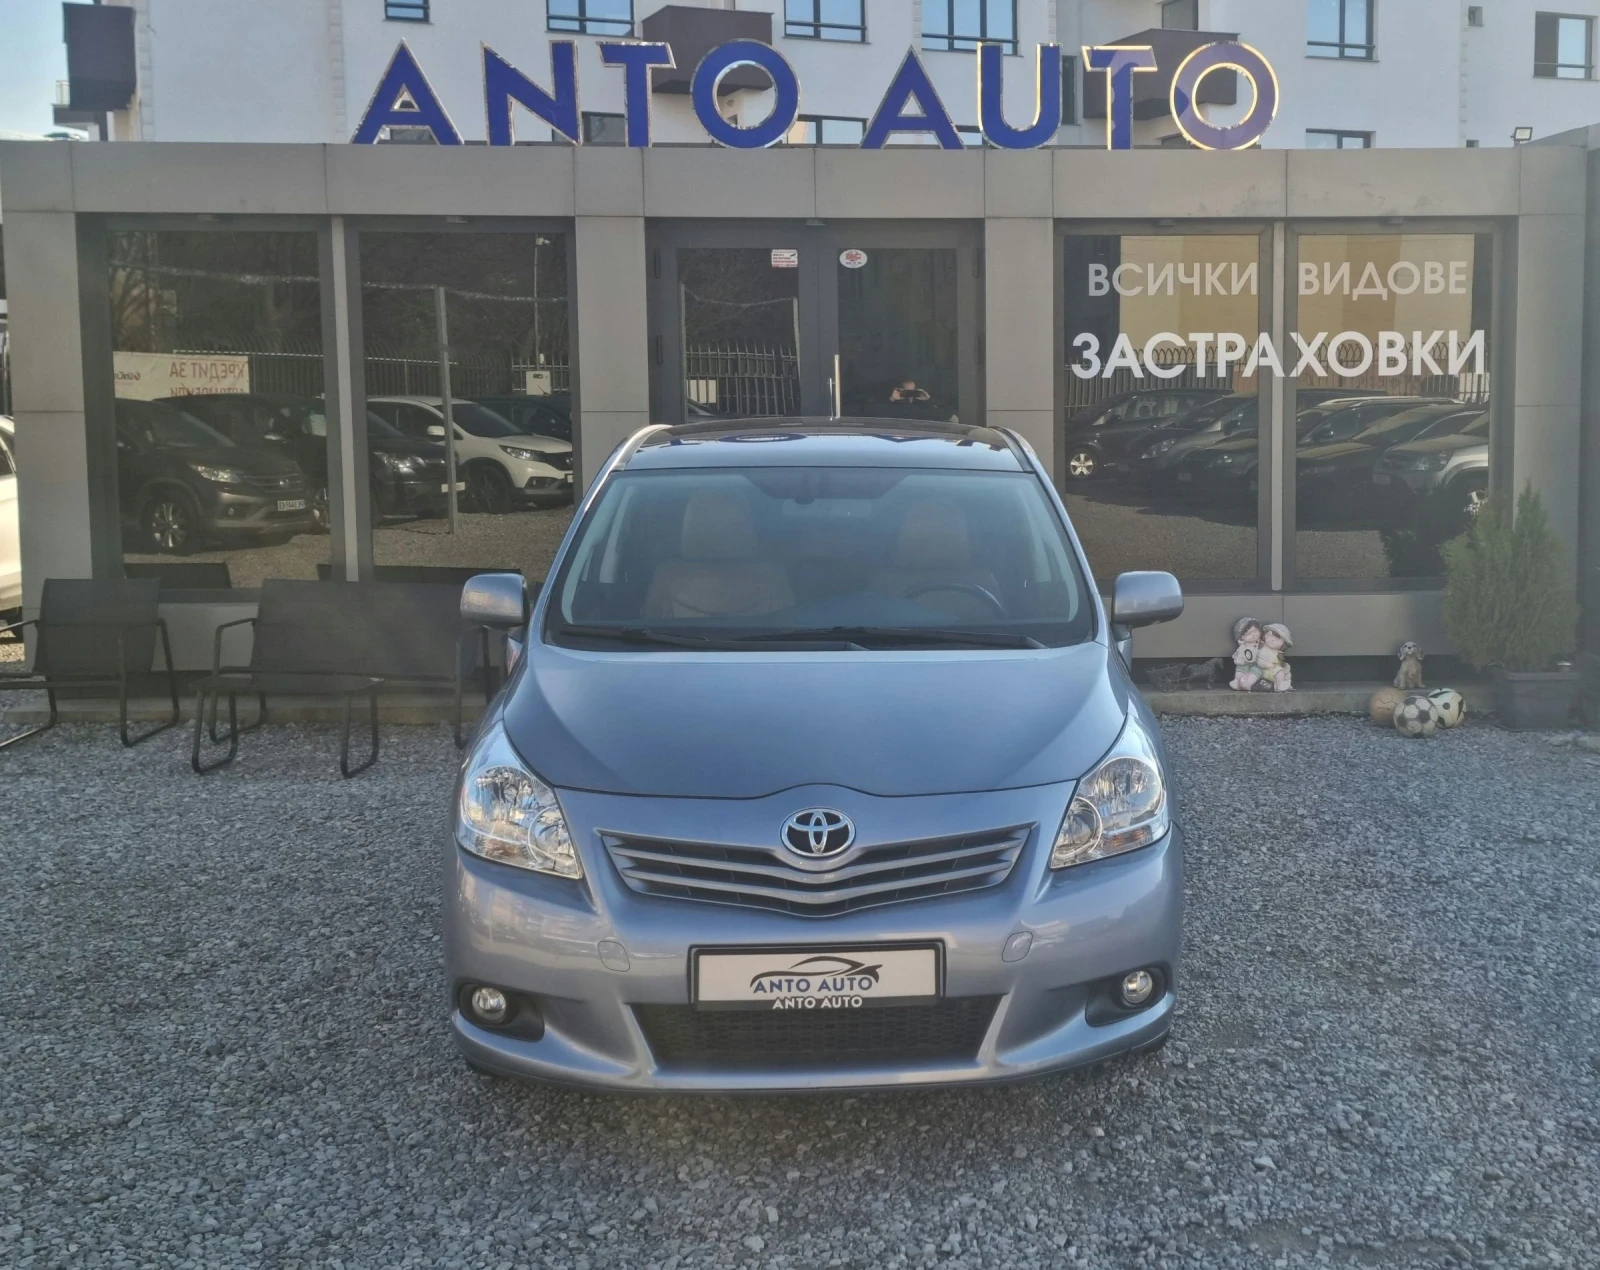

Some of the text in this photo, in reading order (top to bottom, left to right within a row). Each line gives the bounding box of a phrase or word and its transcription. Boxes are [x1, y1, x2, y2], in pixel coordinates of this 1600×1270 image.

[352, 39, 1280, 150] ANTO AUTO
[1088, 261, 1468, 301] ВСИЧКИ ВИДОВЕ
[1071, 329, 1486, 379] ЗАСТРАХОВКИ
[753, 976, 873, 993] ANTO AUTO
[773, 996, 863, 1010] ANTO AUTO
